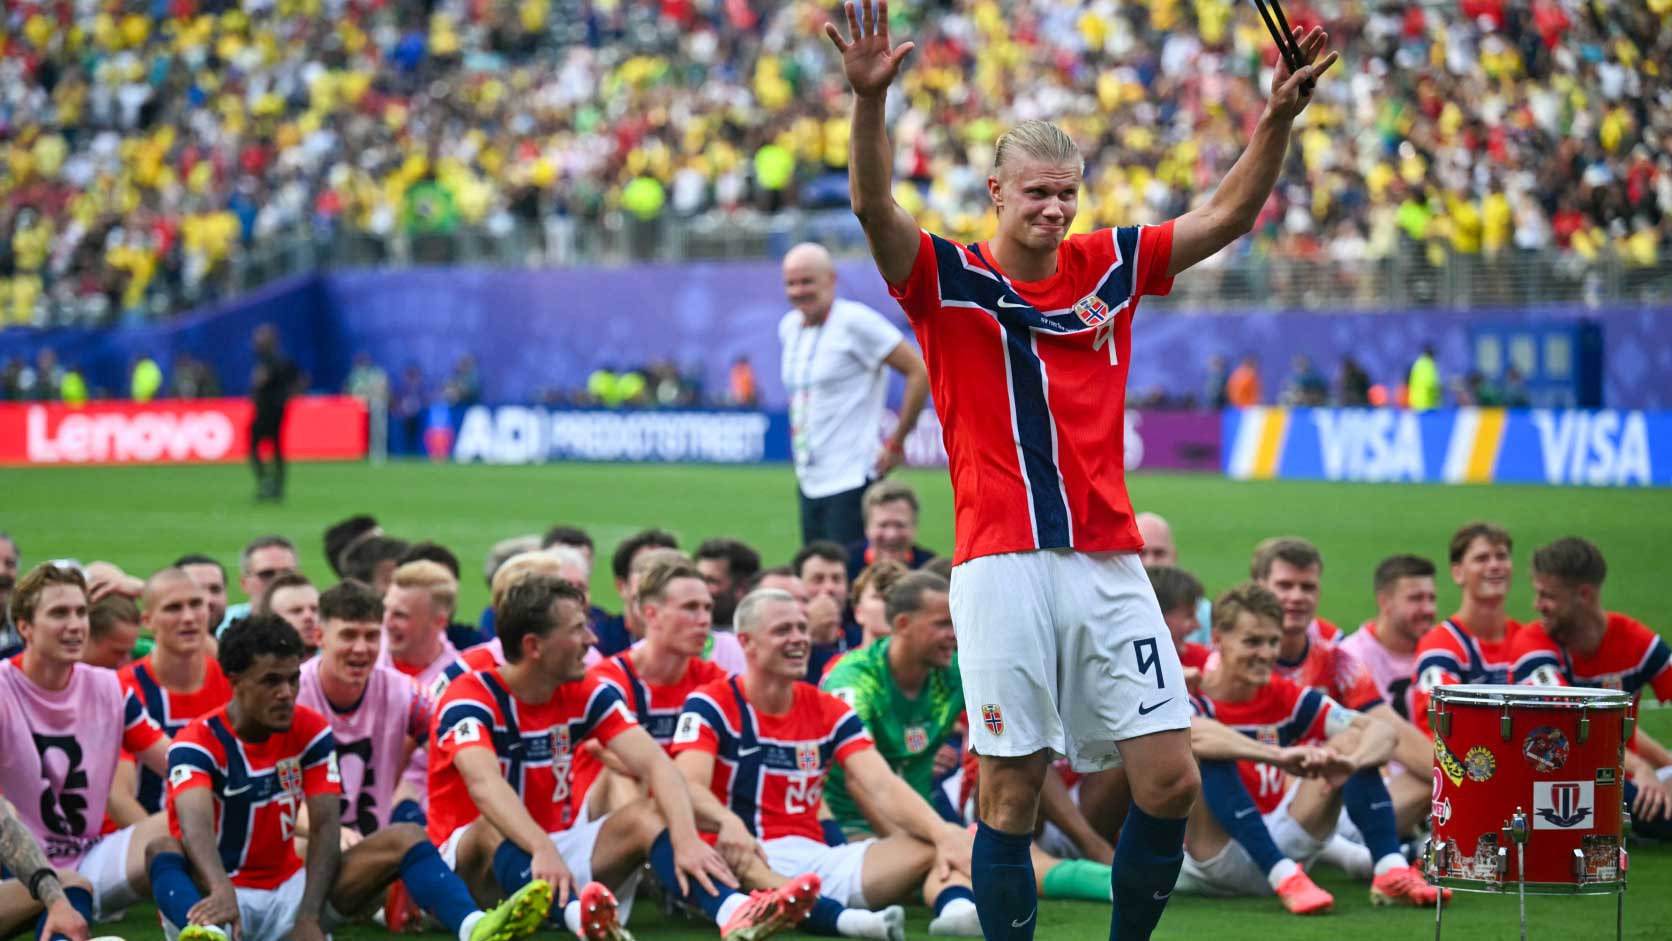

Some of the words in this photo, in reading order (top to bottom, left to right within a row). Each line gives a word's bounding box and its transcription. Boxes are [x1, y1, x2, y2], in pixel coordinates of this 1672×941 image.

[1093, 316, 1119, 366] 9
[27, 404, 234, 462] Lenovo
[1313, 407, 1424, 481] VISA
[1532, 408, 1652, 484] VISA
[1133, 637, 1165, 689] 9
[551, 762, 571, 803] 8
